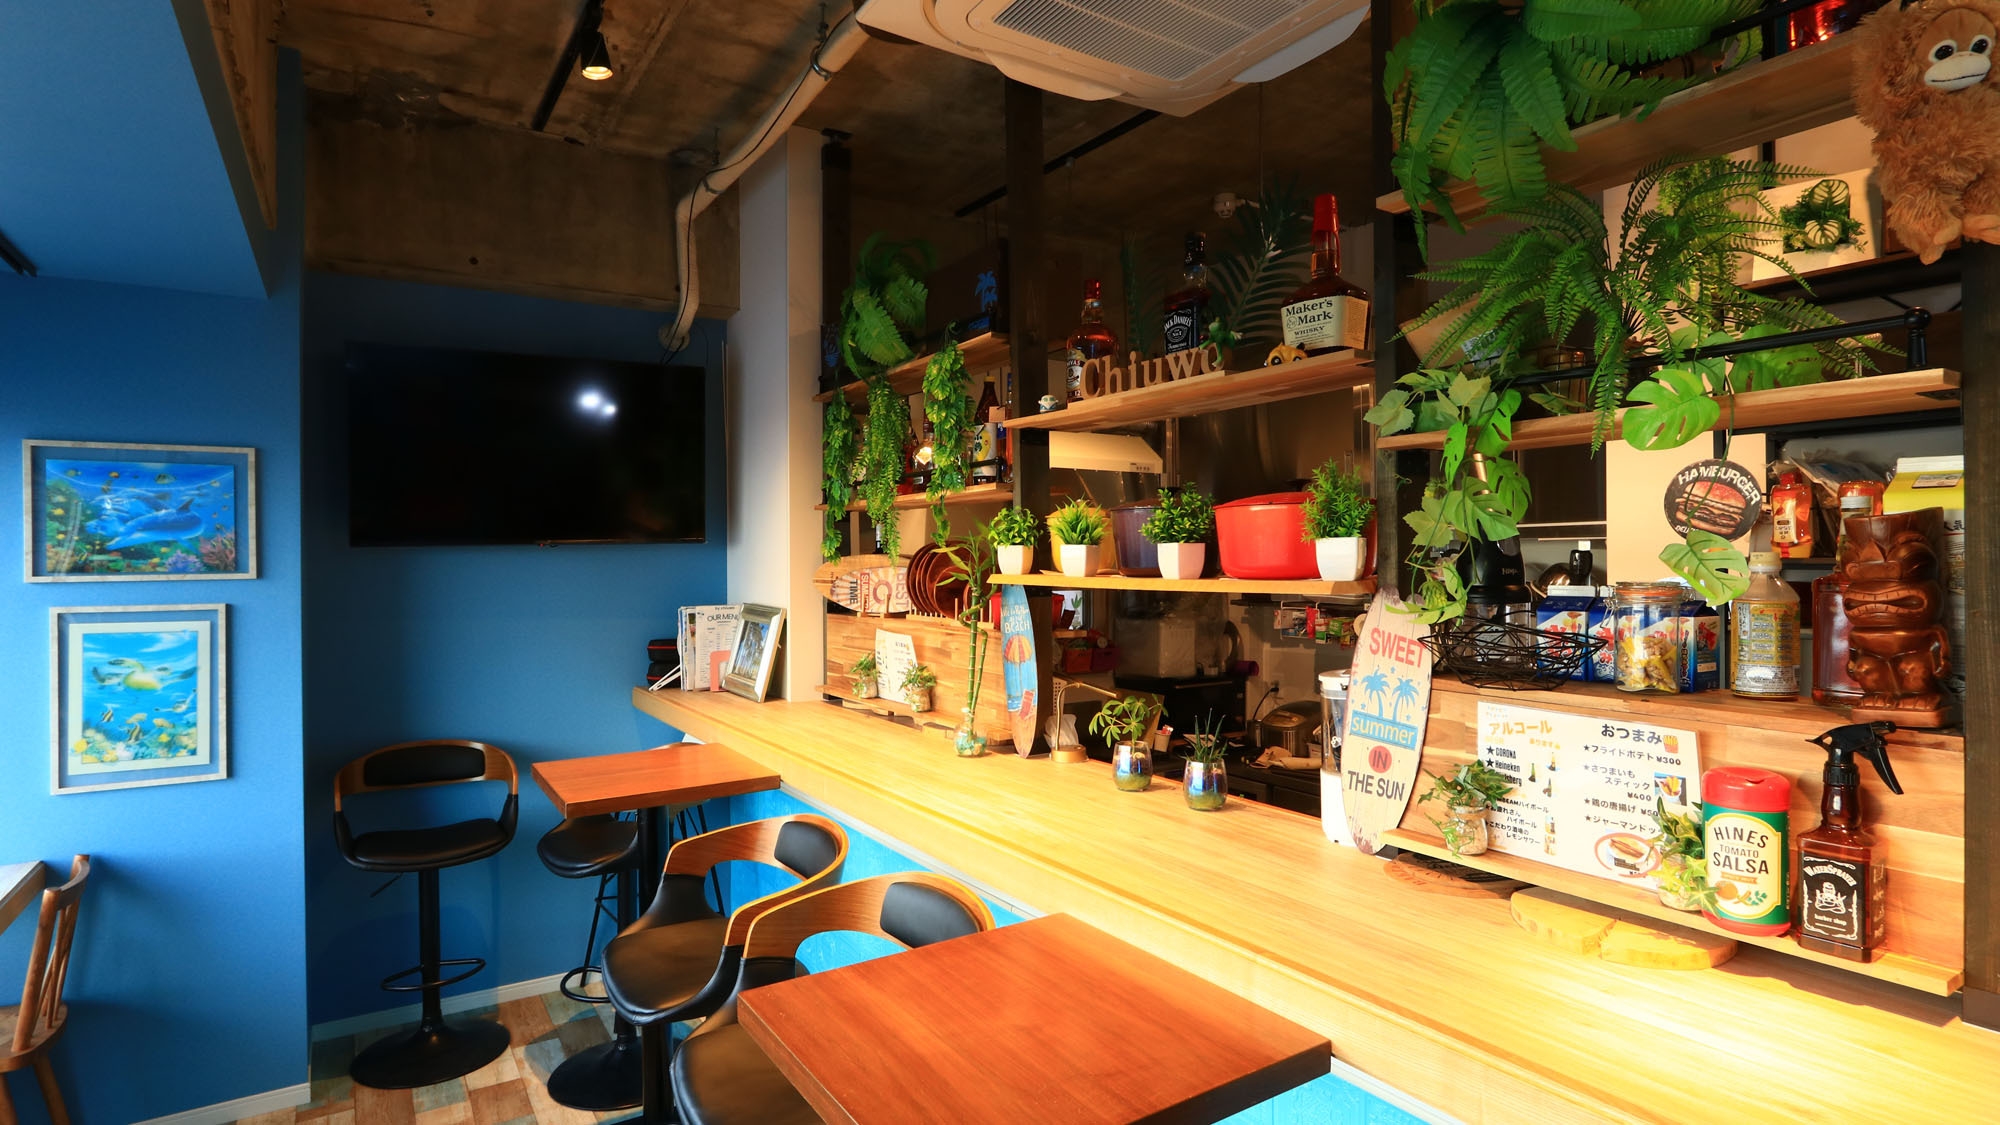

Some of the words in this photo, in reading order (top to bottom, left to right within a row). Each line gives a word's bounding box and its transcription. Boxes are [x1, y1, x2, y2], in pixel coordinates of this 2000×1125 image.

[1286, 299, 1333, 317] Maker's
[1298, 311, 1333, 326] Mark
[1294, 326, 1325, 336] WHISKY
[849, 579, 859, 605] TIME
[1369, 627, 1426, 668] SWEET
[1352, 716, 1415, 745] summer
[1489, 720, 1552, 735] アルコール
[1601, 723, 1662, 744] おつまみ
[1372, 750, 1389, 770] IN
[1496, 747, 1516, 759] CORONA
[1656, 755, 1681, 766] ¥300
[1495, 760, 1520, 773] Heineken
[1591, 764, 1635, 778] さつまいも
[1347, 771, 1374, 795] THE
[1376, 777, 1405, 801] SUN
[1604, 777, 1650, 790] スティック
[1627, 792, 1652, 801] ¥400
[1640, 808, 1659, 817] ¥50
[1593, 815, 1657, 834] ジャーマンドッ
[1713, 826, 1769, 848] HINES
[1719, 844, 1759, 858] TOMATO
[1713, 852, 1769, 875] SALSA
